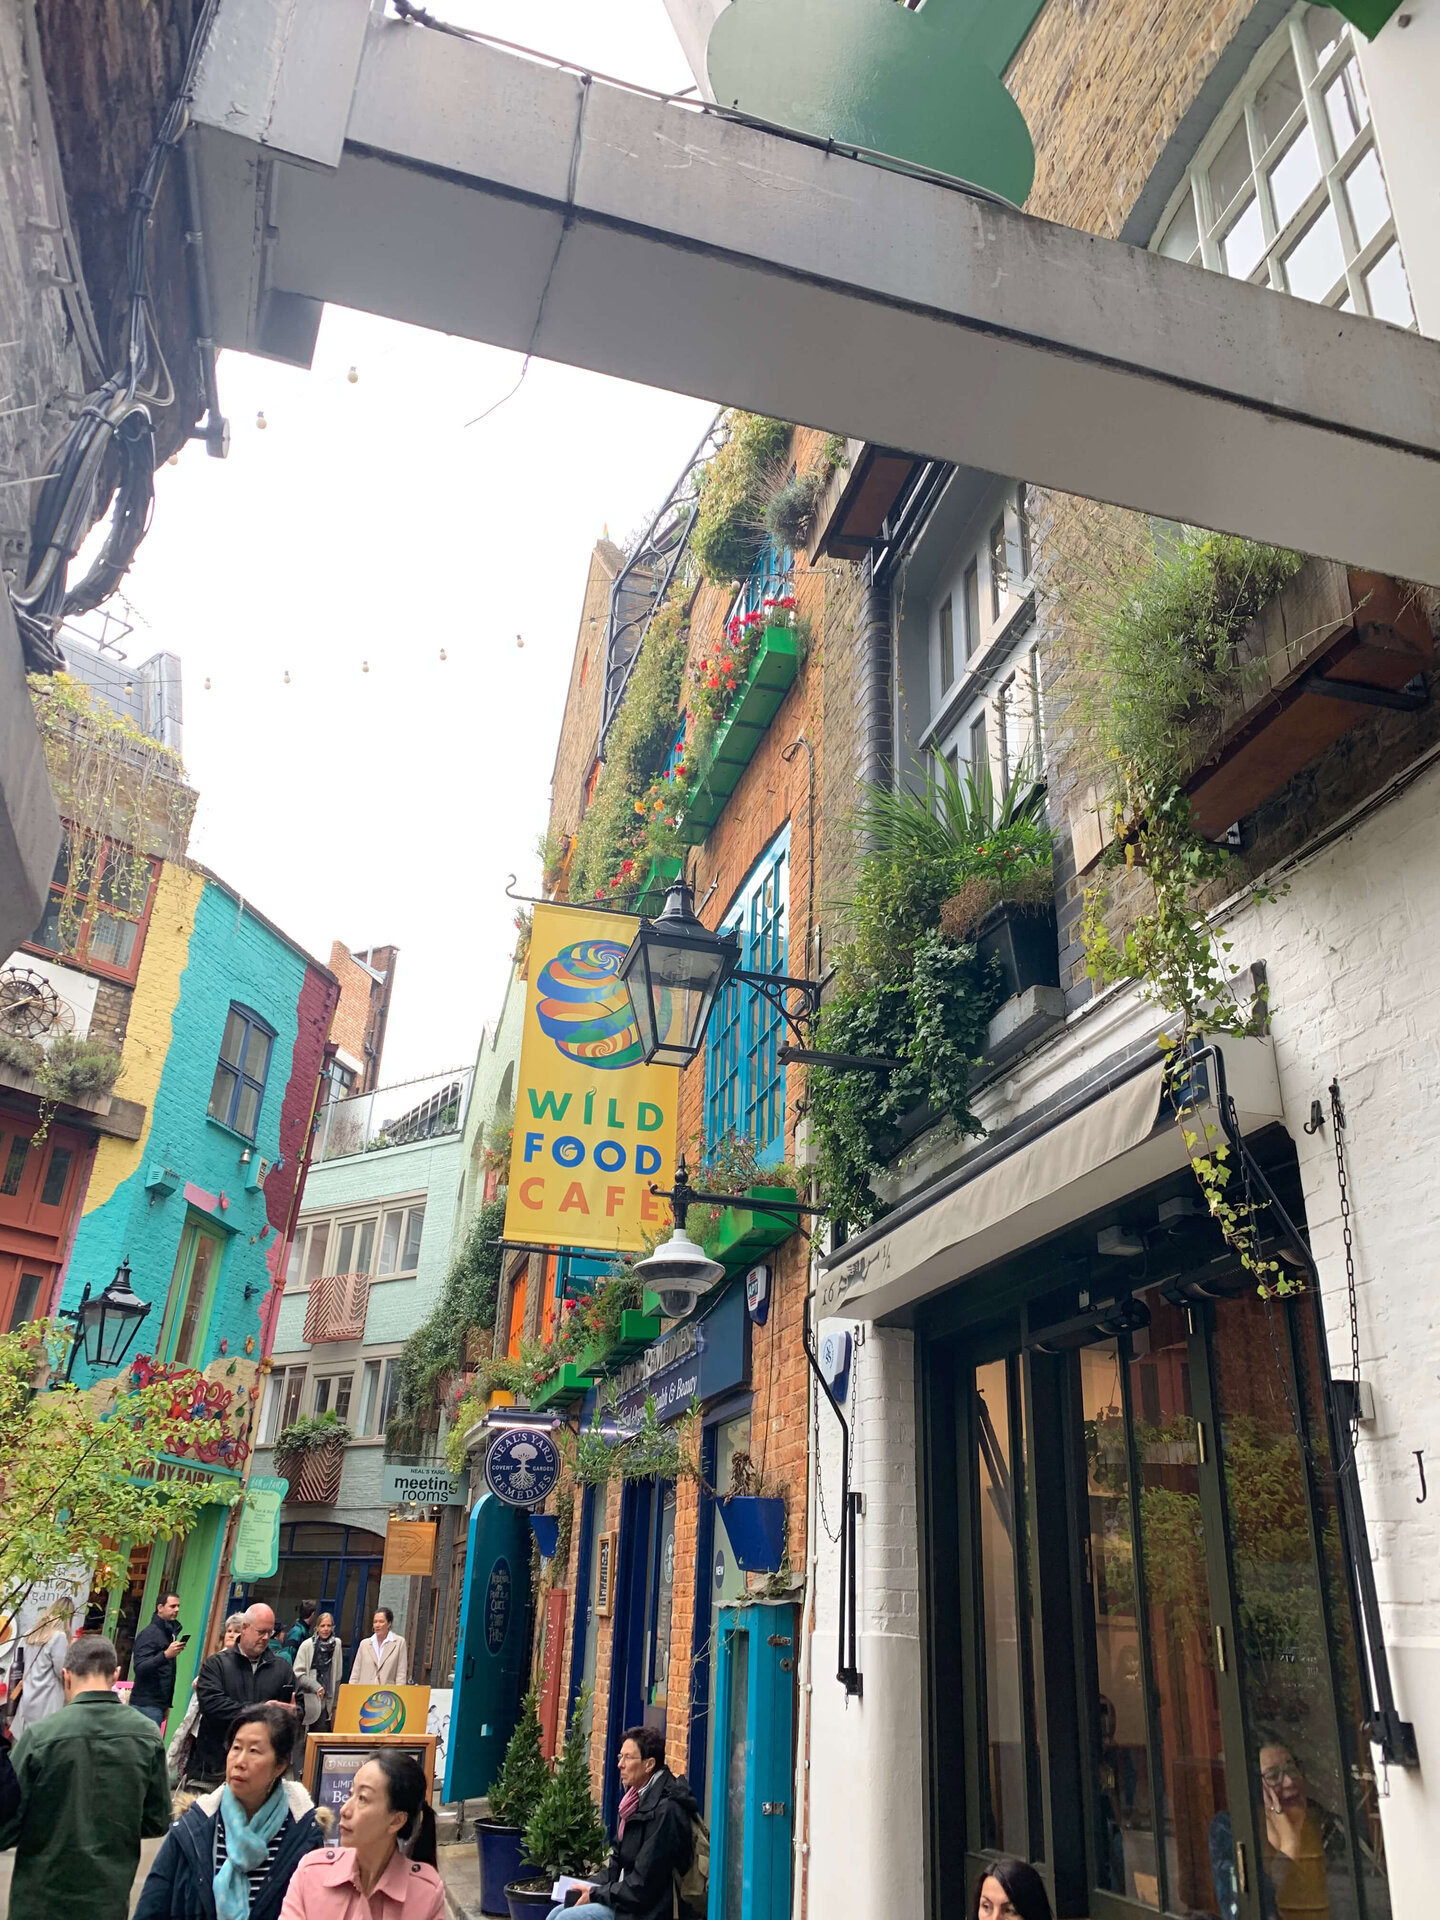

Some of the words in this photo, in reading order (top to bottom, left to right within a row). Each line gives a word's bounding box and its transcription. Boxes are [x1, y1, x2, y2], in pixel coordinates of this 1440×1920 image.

[526, 1085, 664, 1132] WILD
[523, 1132, 662, 1175] FOOD
[493, 1433, 528, 1462] NEAL'S
[531, 1435, 554, 1463] YARD
[394, 1476, 459, 1494] meeting
[402, 1489, 449, 1502] rooms
[494, 1474, 552, 1499] REMEDIES
